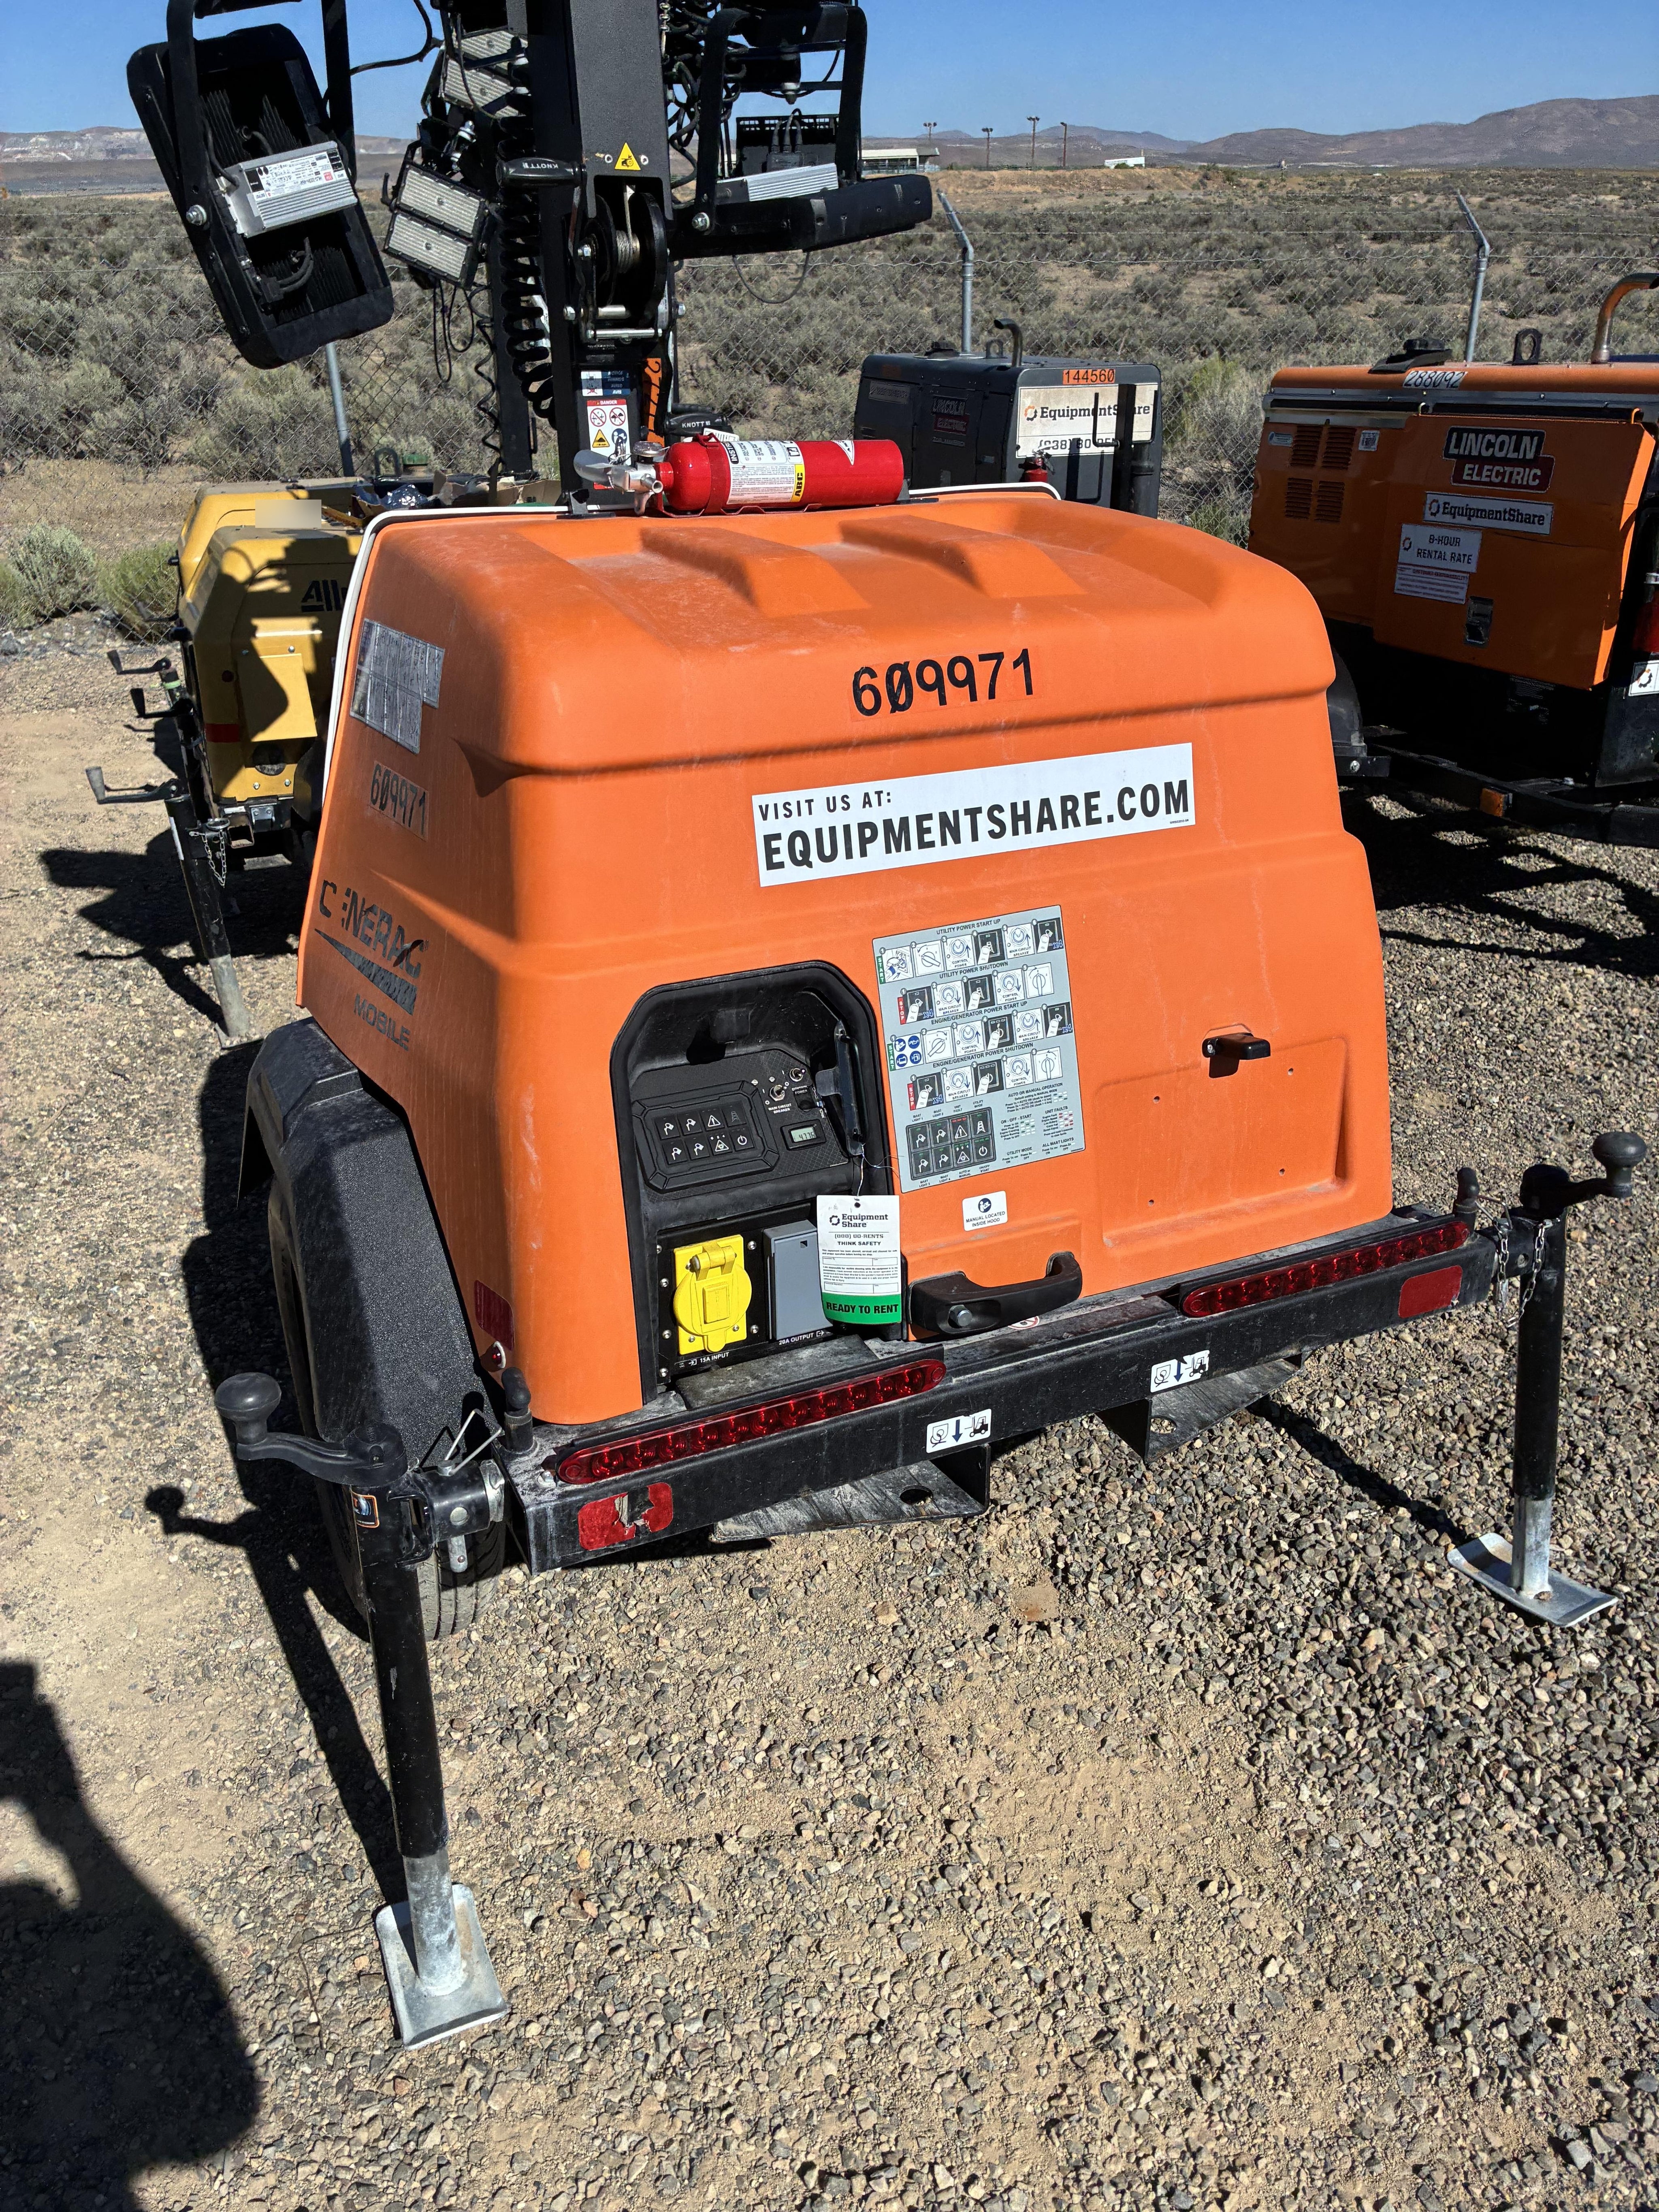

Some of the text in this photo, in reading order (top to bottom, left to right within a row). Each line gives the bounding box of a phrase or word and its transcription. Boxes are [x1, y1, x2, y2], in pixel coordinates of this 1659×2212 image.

[1065, 369, 1115, 383] 144560
[1404, 371, 1465, 388] 288092
[1448, 432, 1539, 459] LINCOLN
[795, 473, 803, 497] ABC
[1463, 463, 1541, 486] ELECTRIC
[1442, 501, 1545, 526] EquipmentShare
[1417, 548, 1473, 564] RENTAL RATE
[851, 648, 1034, 717] 609971
[370, 764, 426, 836] 609971
[758, 790, 892, 821] VISIT US AT:
[763, 779, 1190, 871] EQUIPMENTSHARE.COM
[936, 927, 956, 935] UTILITY
[939, 961, 1008, 979] UTILITY POWER SHUTDOWN
[354, 994, 410, 1051] MOBILE
[931, 1009, 983, 1025] ENGINE/GENERATOR
[984, 1005, 1002, 1014] POWER
[1003, 1002, 1021, 1010] START
[933, 1042, 1033, 1068] ENGINE/GENERATOR POWER SHUTDOWN
[826, 1301, 899, 1314] READY TO RENT
[790, 1333, 814, 1343] OUTPUT
[712, 1352, 729, 1361] INPUT
